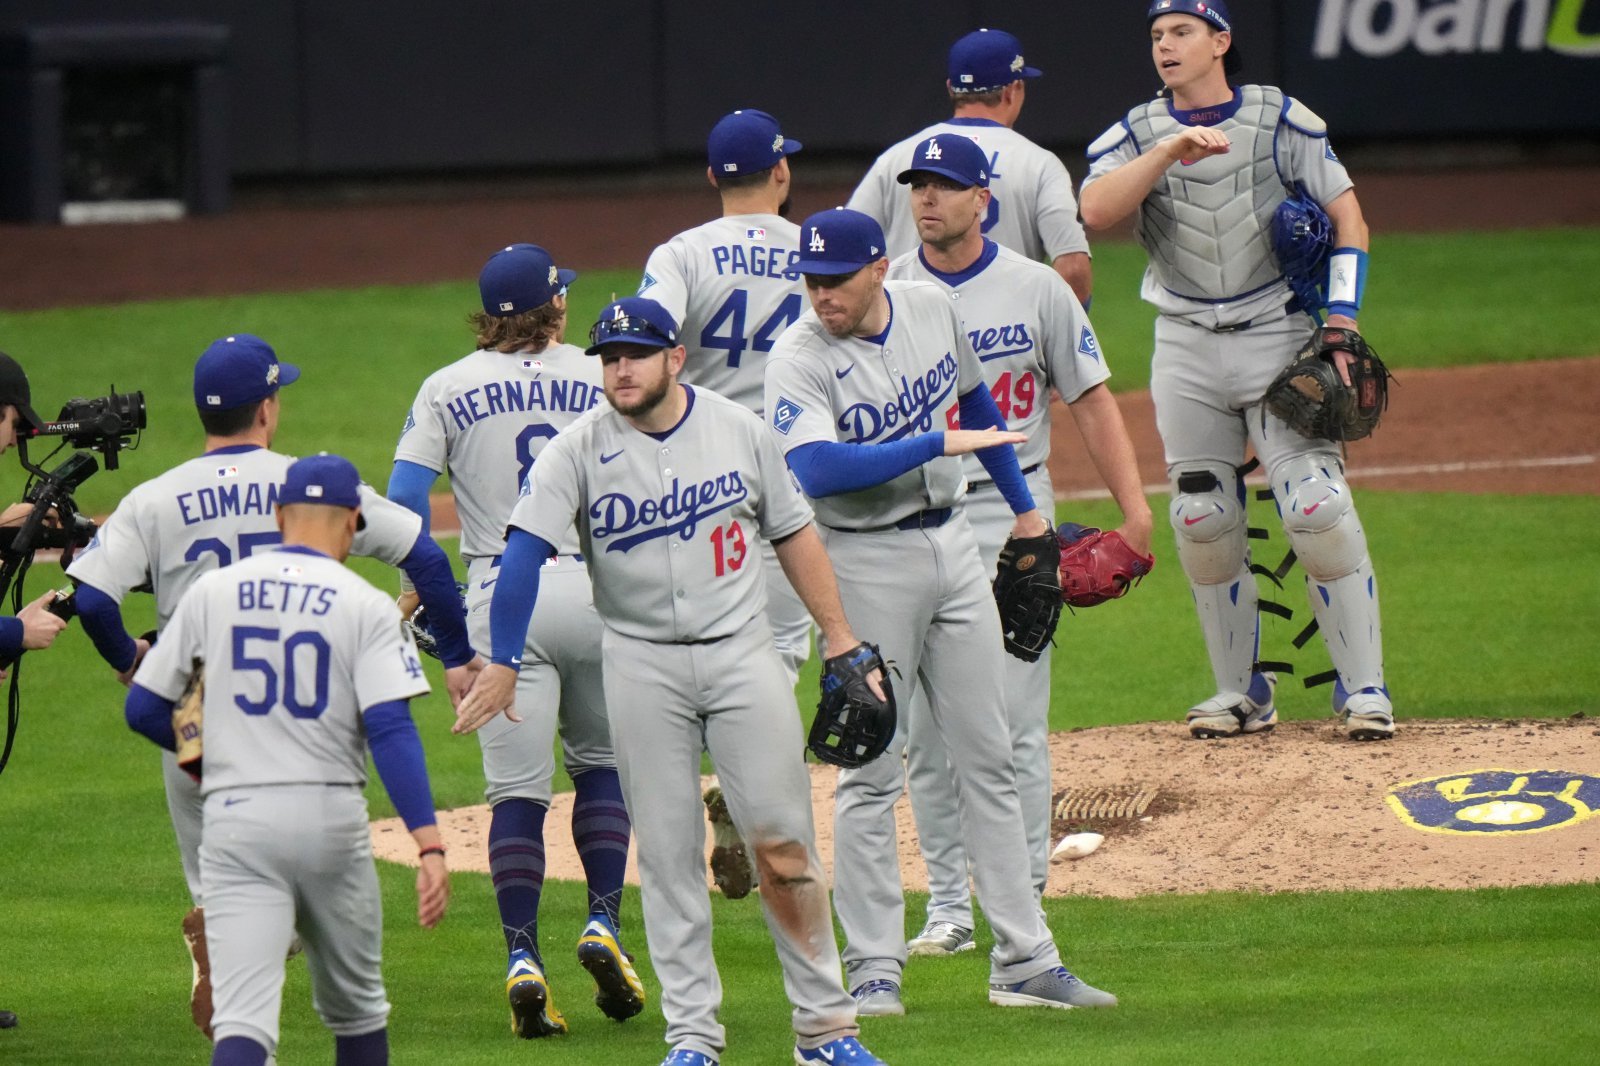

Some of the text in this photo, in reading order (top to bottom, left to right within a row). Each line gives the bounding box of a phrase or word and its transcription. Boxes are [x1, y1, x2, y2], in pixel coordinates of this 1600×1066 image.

[1189, 111, 1222, 121] SMITH
[925, 139, 942, 160] LA
[809, 227, 825, 252] LA
[701, 289, 802, 368] 44
[838, 352, 958, 445] Dodgers
[991, 371, 1035, 420] 49
[590, 471, 748, 554] Dodgers
[710, 520, 747, 577] 13
[239, 579, 337, 616] BETTS
[232, 625, 331, 719] 50
